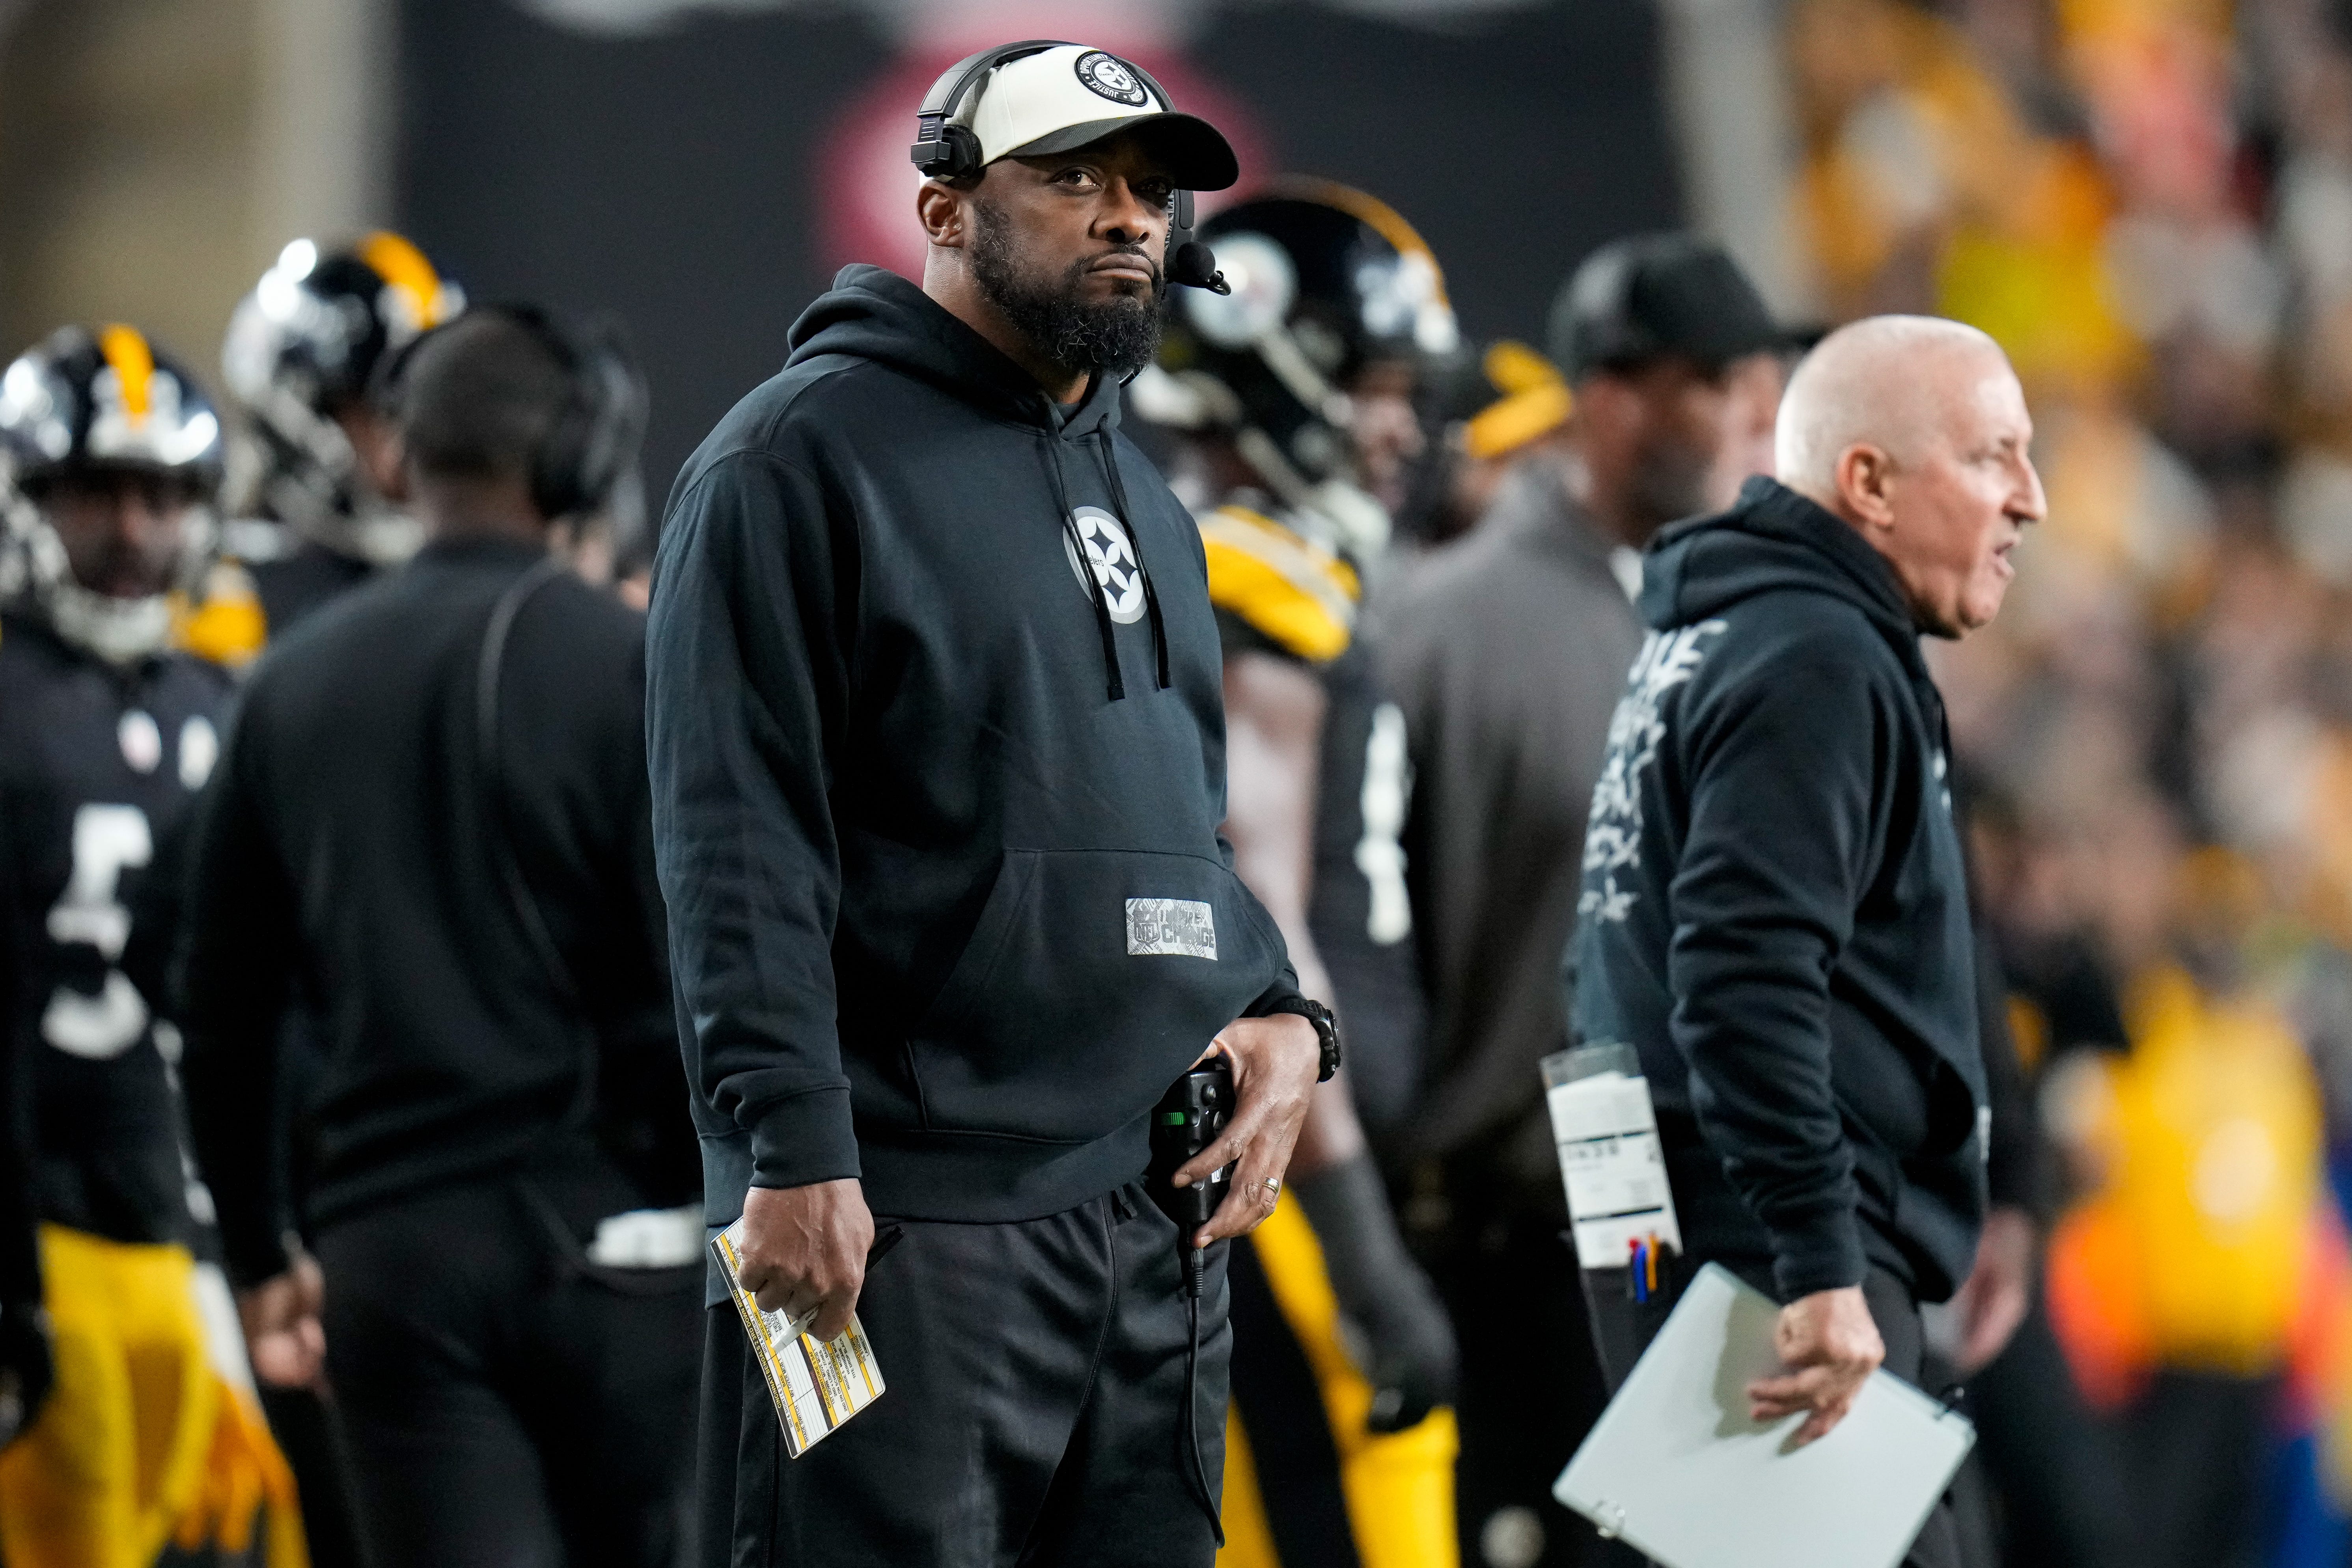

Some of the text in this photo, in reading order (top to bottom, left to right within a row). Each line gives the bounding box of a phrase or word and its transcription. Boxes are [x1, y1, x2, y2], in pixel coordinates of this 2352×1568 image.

[1080, 54, 1108, 74] OPPORTUNITY
[1088, 80, 1119, 98] JUSTICE
[1089, 554, 1104, 567] elers
[732, 1249, 740, 1266] NSIDE
[733, 1288, 743, 1308] MENU
[740, 1307, 751, 1327] DOWN
[754, 1310, 768, 1341] NICKEL/DIME
[764, 1311, 772, 1328] TESLA
[770, 1317, 778, 1332] FIELD
[772, 1311, 782, 1330] BUCKE
[752, 1320, 761, 1339] MEDIUM
[839, 1337, 847, 1354] BLACK
[850, 1337, 858, 1354] DOWN
[854, 1334, 864, 1355] STRONG
[858, 1333, 869, 1356] LAMBERT
[756, 1345, 770, 1374] BENGALS
[829, 1351, 842, 1382] OKIE/PENNY
[838, 1346, 850, 1374] HURRICANE
[828, 1361, 838, 1386] SCHEDULE
[767, 1374, 782, 1409] CINCINNATI
[789, 1389, 795, 1397] MV
[815, 1365, 832, 1408] OKIE/PENNY/OKIE
[795, 1404, 803, 1425] SWITCH
